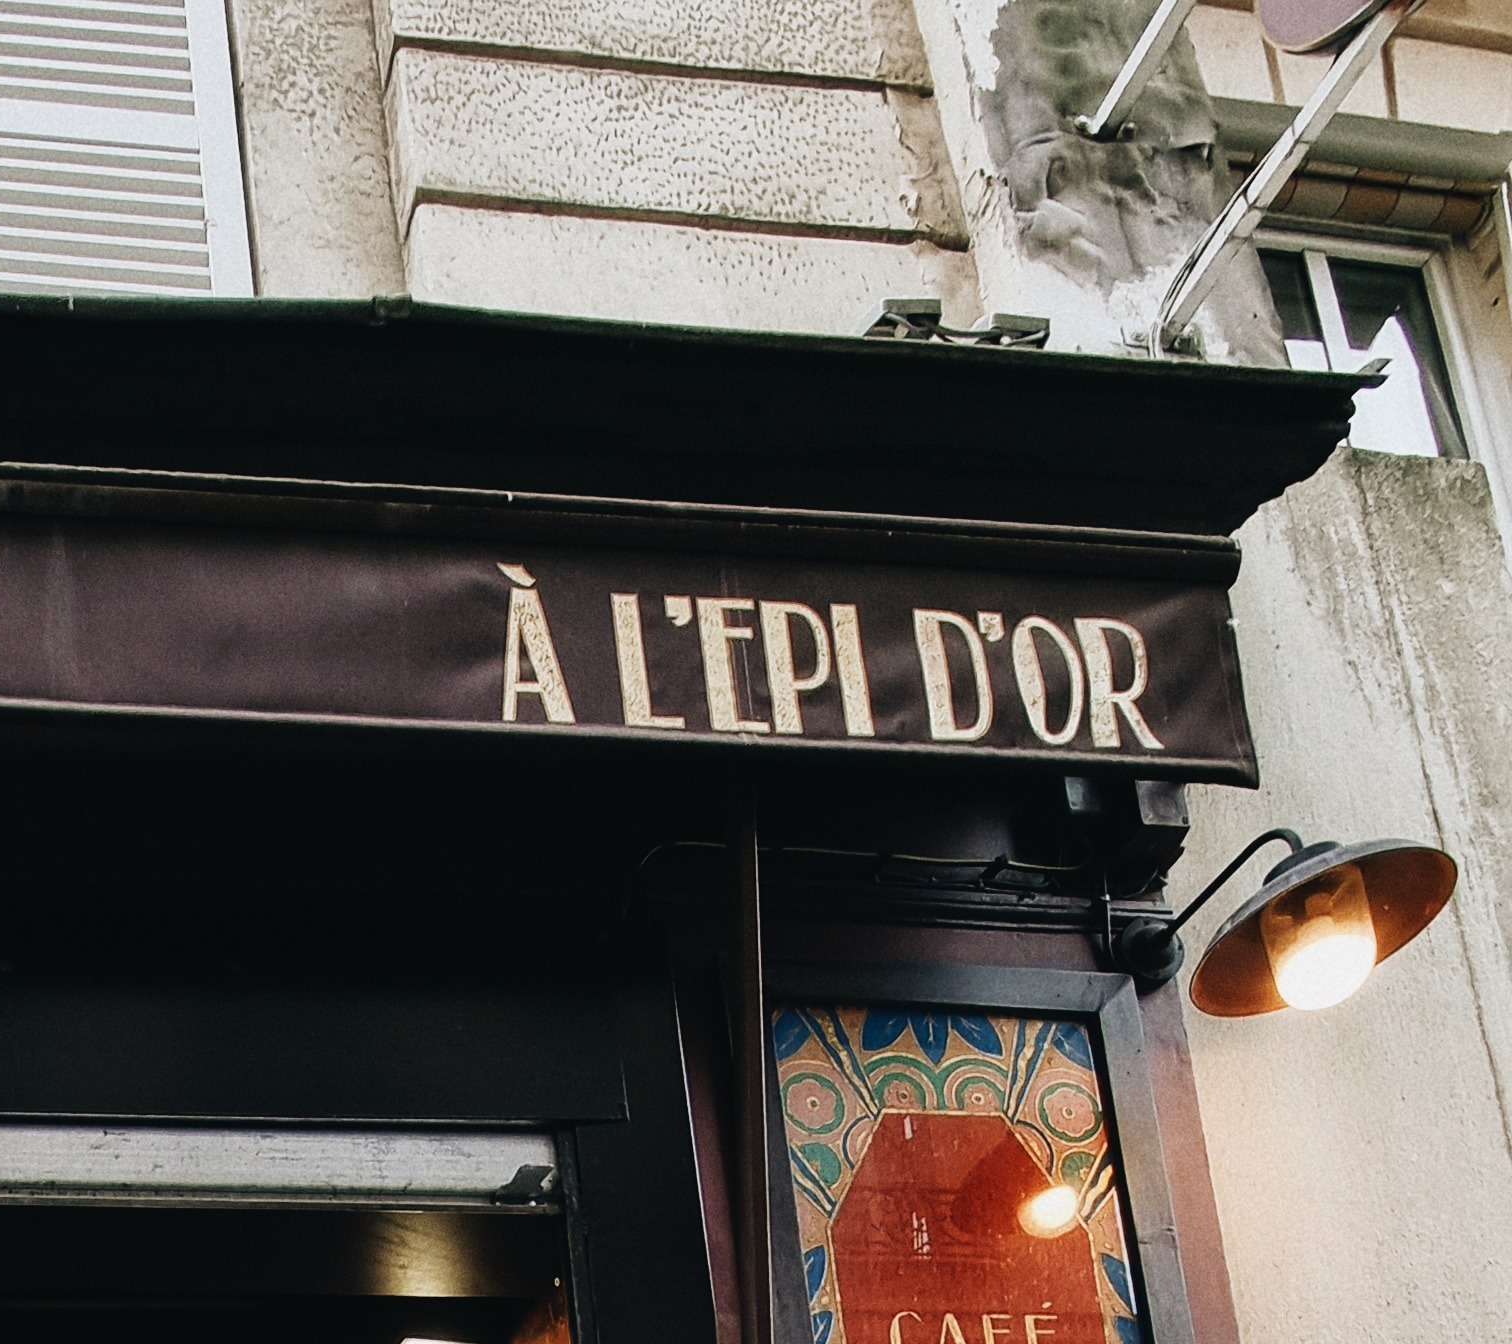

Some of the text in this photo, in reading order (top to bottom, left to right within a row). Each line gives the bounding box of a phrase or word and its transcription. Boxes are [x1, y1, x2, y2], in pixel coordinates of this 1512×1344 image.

[496, 561, 1165, 750] À L'EPI D'OR
